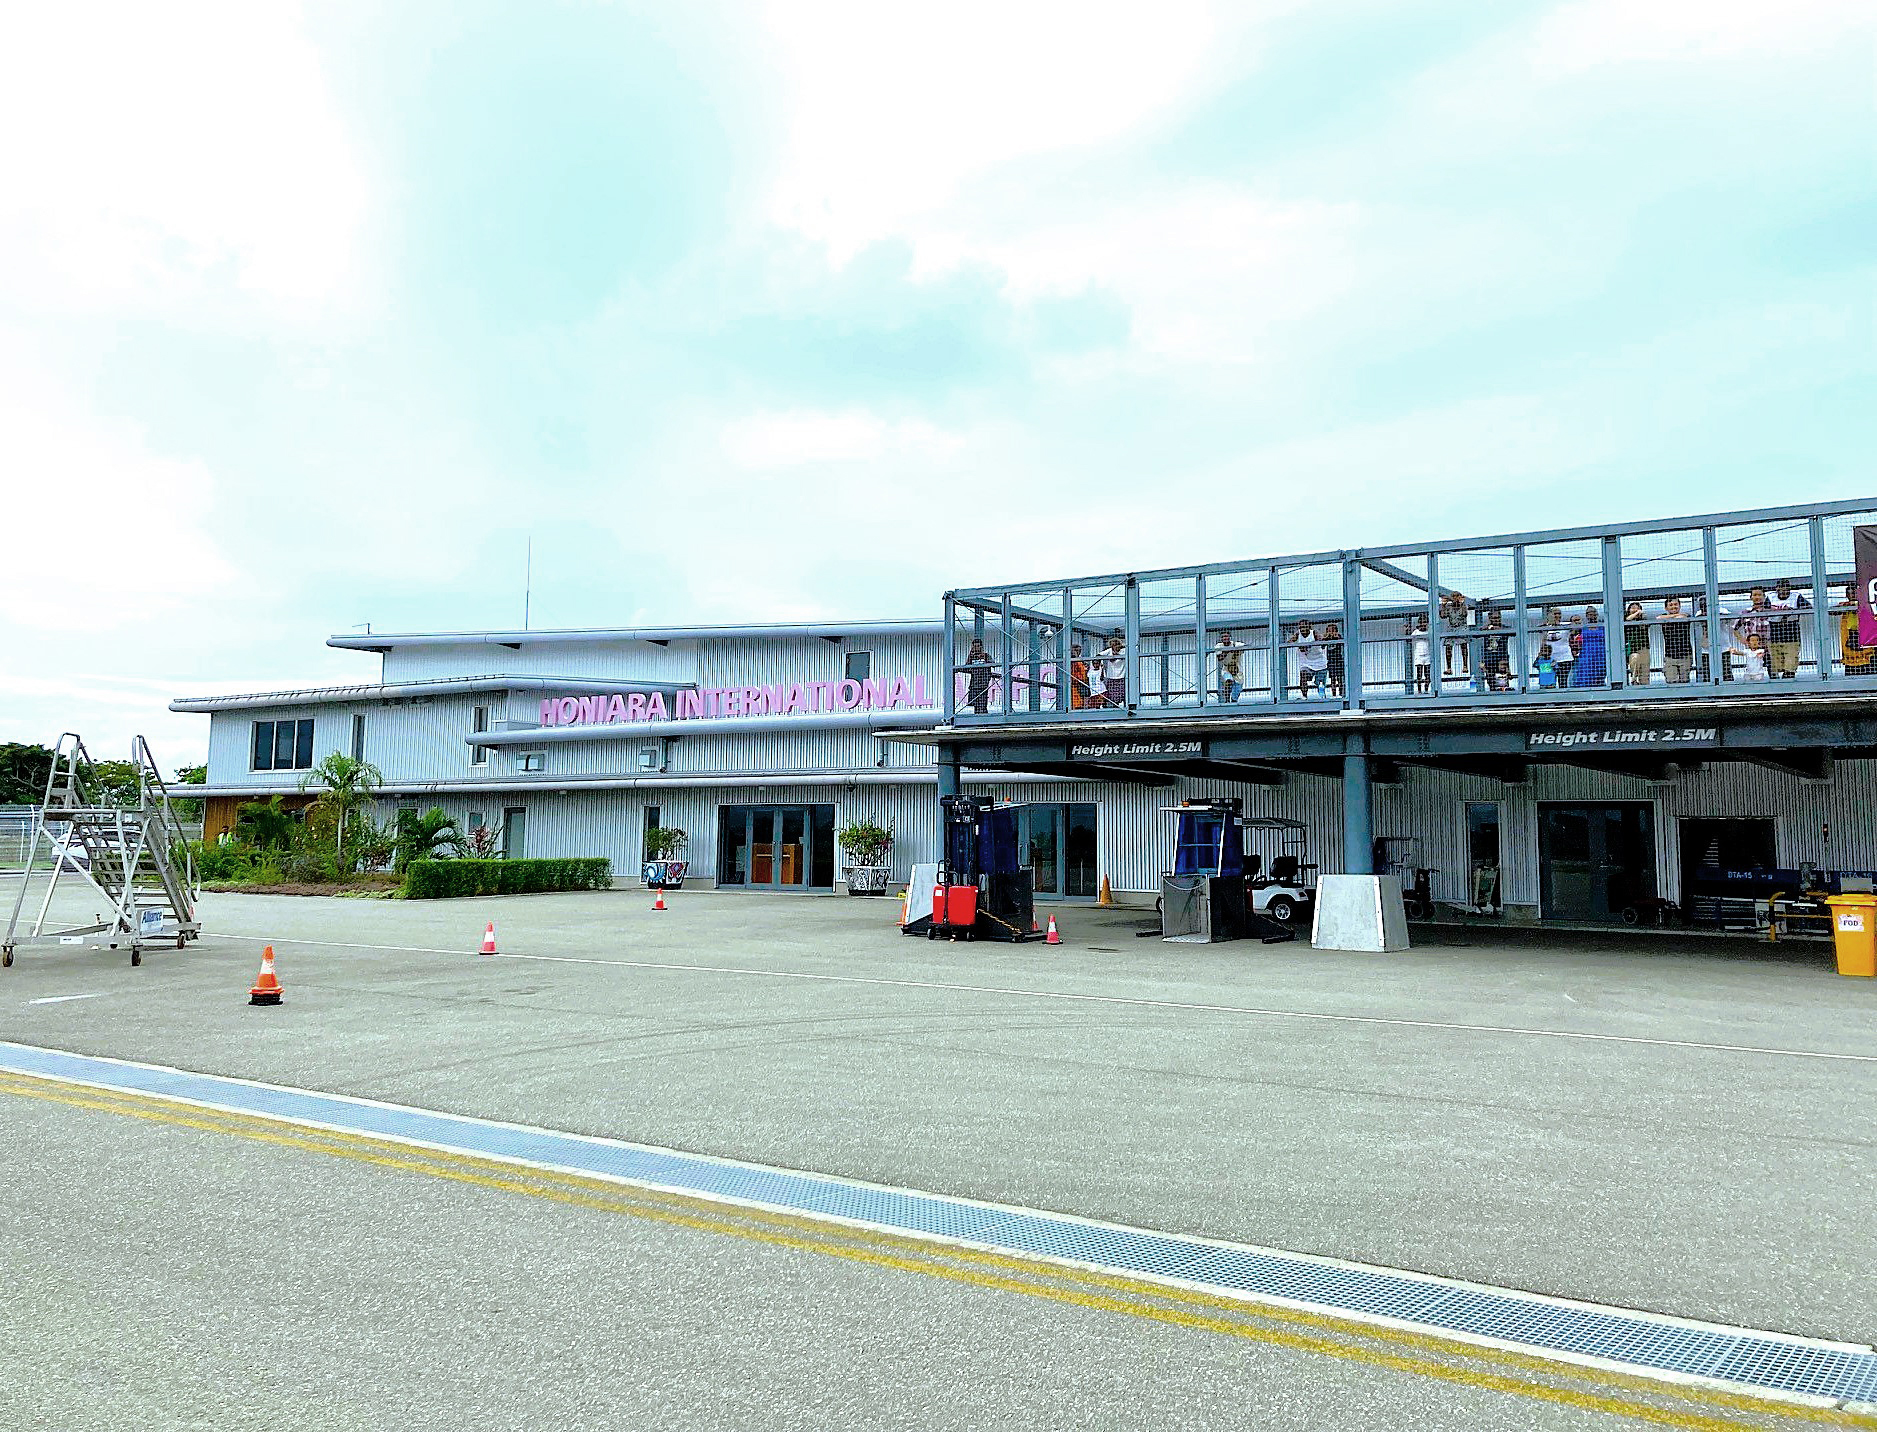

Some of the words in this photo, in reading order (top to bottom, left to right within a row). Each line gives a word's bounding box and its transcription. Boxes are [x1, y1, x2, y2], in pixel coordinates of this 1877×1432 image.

[539, 690, 669, 725] HONIARA
[675, 674, 934, 717] INTERNATIONAL
[1529, 732, 1599, 747] Height
[1602, 729, 1658, 743] Limit
[1661, 728, 1718, 742] 2.5M
[1071, 744, 1120, 757] Height
[1122, 742, 1162, 754] Limit
[1164, 741, 1202, 753] 2.5M
[1843, 919, 1859, 927] FOD
